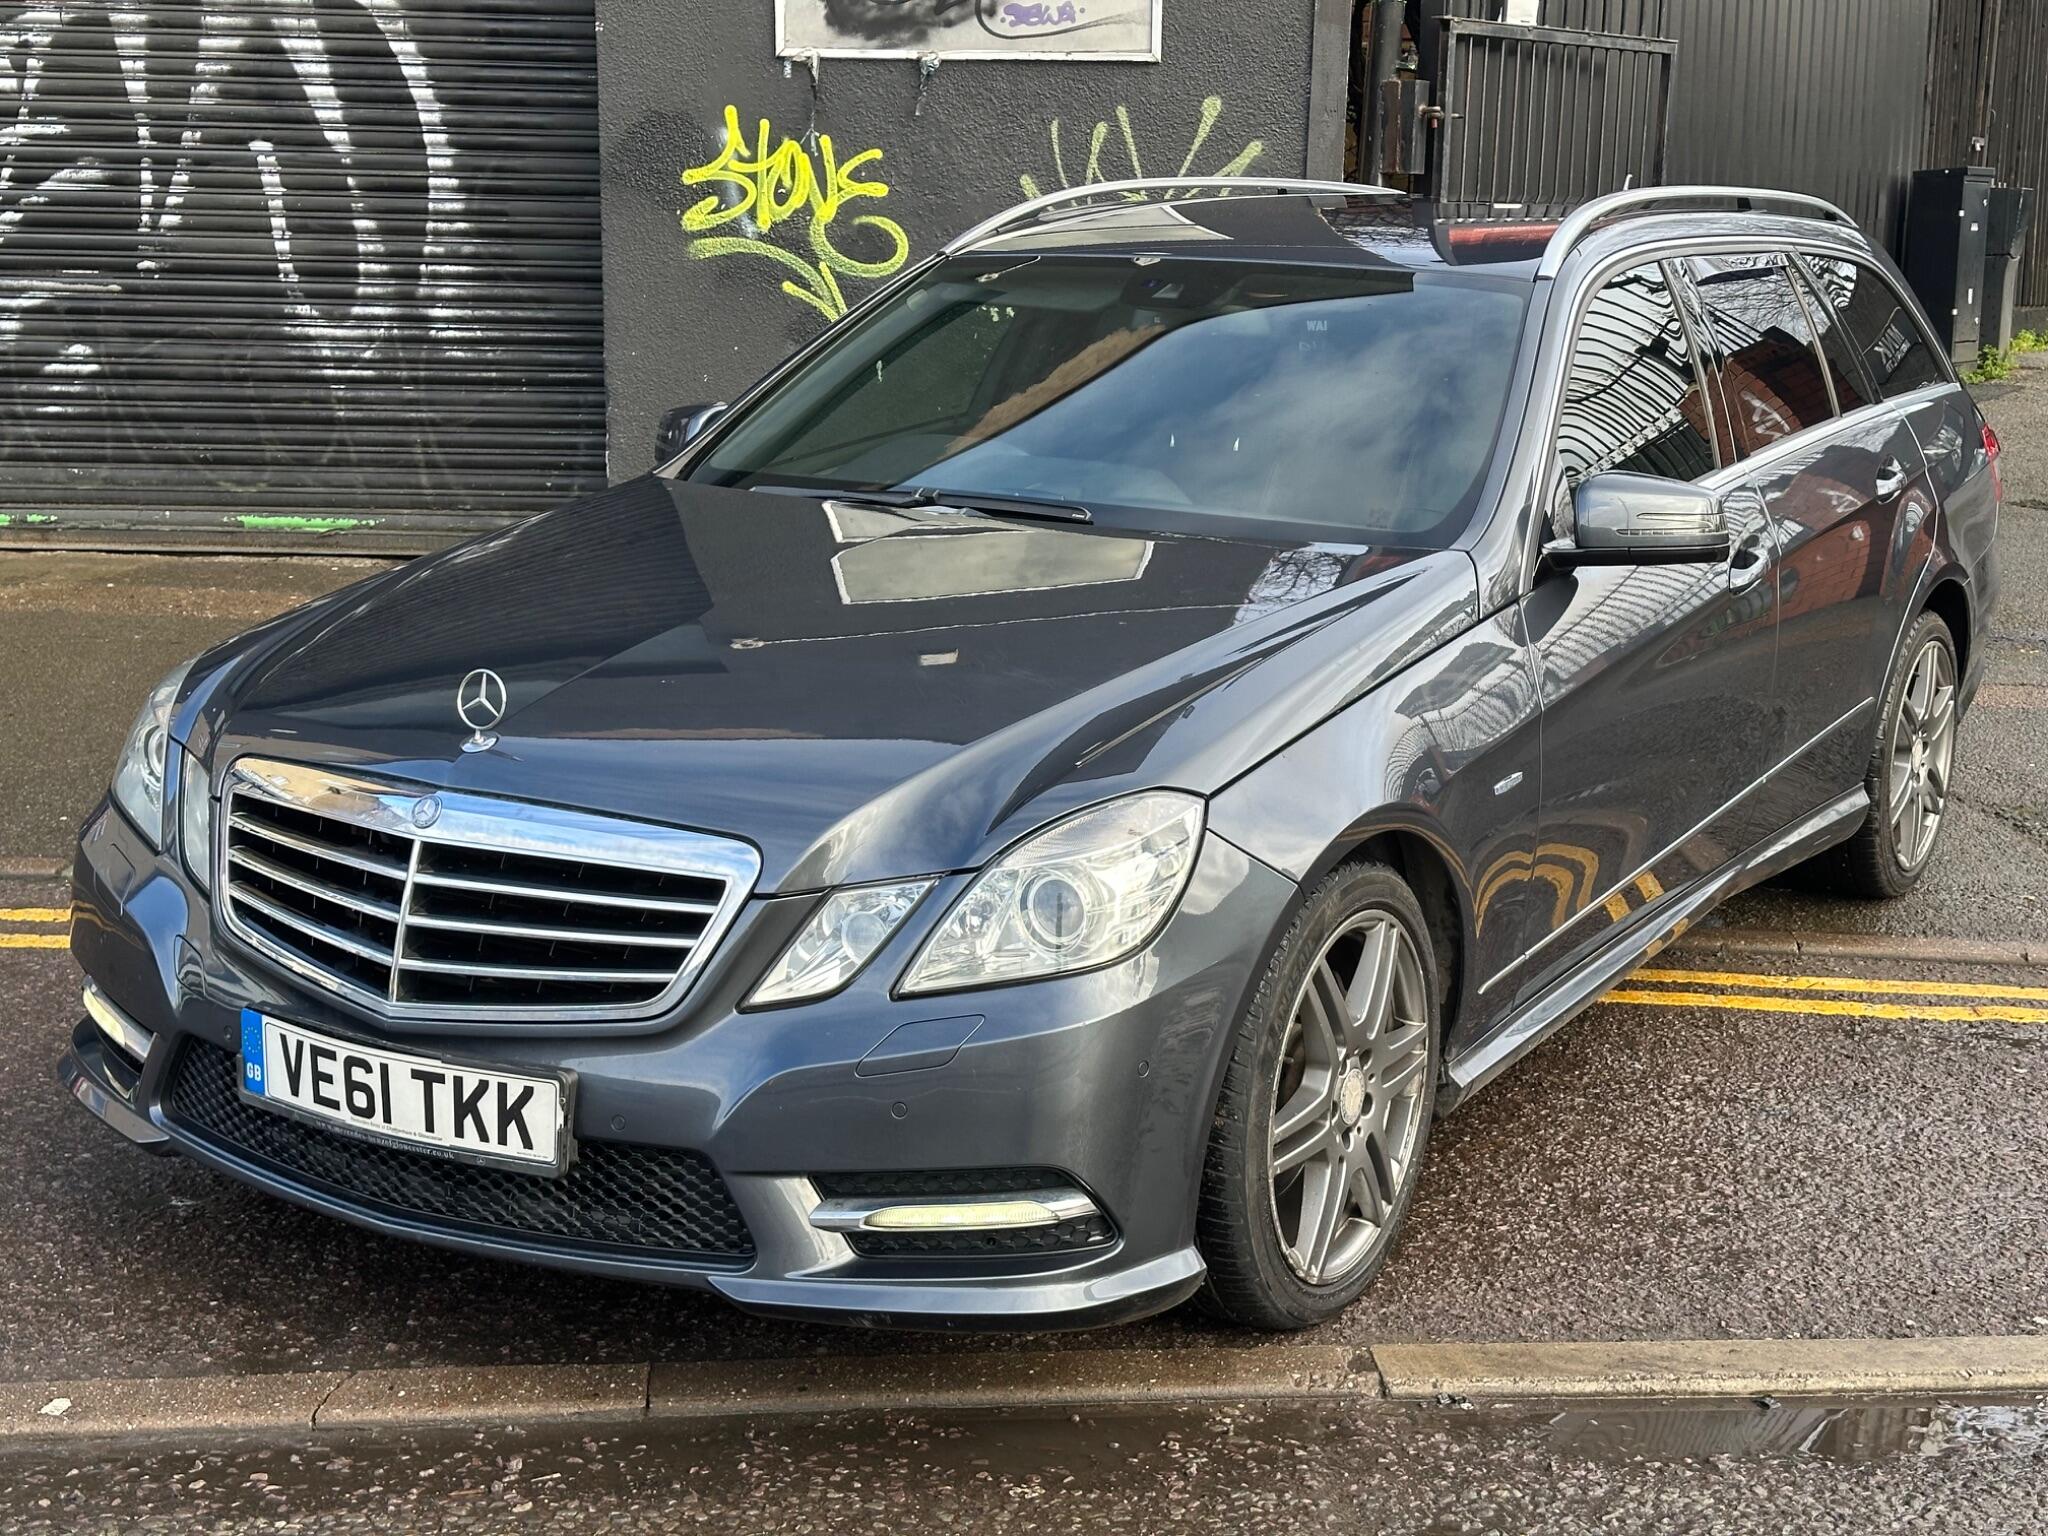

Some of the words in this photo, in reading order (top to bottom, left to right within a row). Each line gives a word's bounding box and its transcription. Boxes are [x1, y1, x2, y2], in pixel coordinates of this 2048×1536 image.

[246, 1061, 262, 1082] GB
[279, 1032, 392, 1125] VE61
[410, 1067, 535, 1151] TKK
